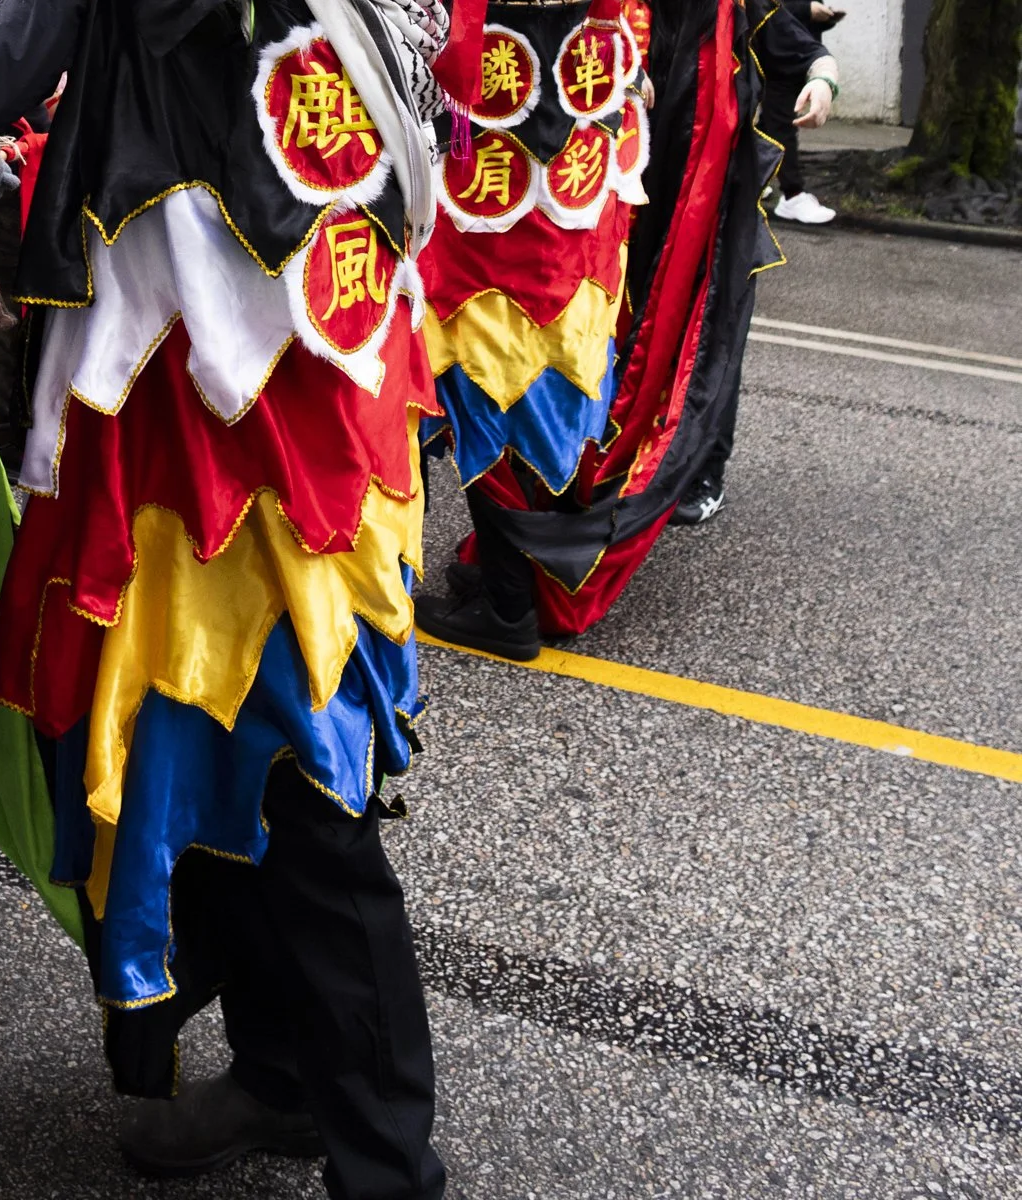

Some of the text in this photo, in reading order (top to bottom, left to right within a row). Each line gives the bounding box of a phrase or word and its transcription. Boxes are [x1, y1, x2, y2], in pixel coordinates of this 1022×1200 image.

[282, 61, 377, 159] 麒
[457, 137, 602, 206] 肩 彩
[321, 219, 386, 320] 風
